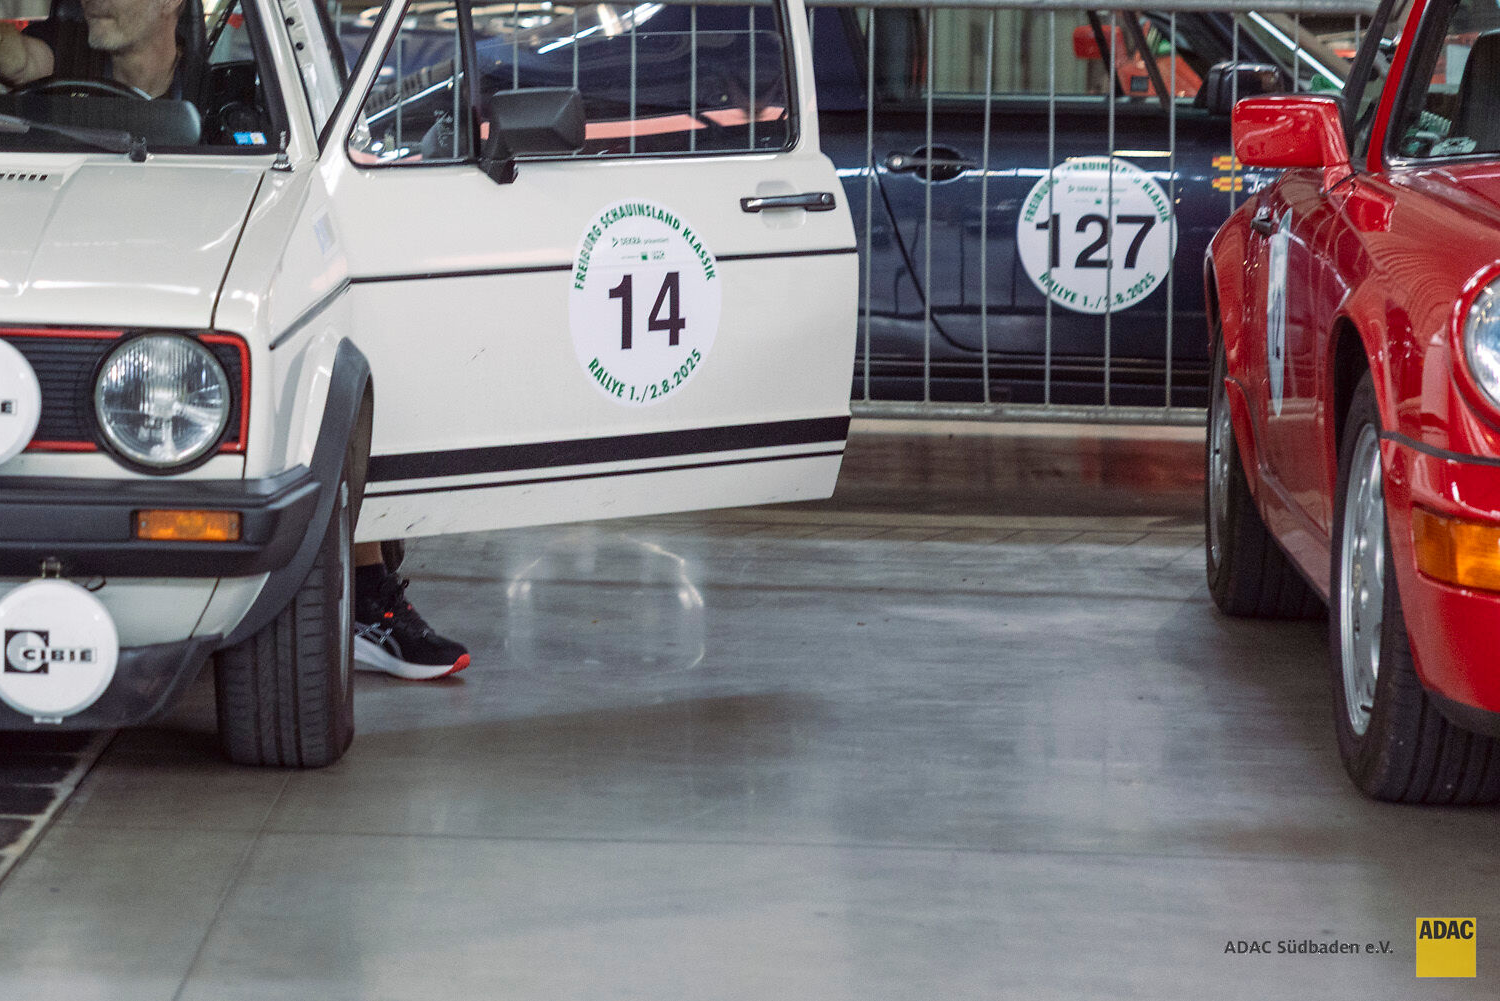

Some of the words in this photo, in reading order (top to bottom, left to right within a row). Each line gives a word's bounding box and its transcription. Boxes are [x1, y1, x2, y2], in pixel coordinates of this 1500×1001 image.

[574, 224, 602, 290] FREIBURG
[599, 203, 681, 231] SCHAUINSLAND
[682, 227, 716, 281] KLASSIK
[1036, 213, 1156, 270] 127
[608, 271, 686, 350] 14
[588, 357, 626, 398] RALLYE
